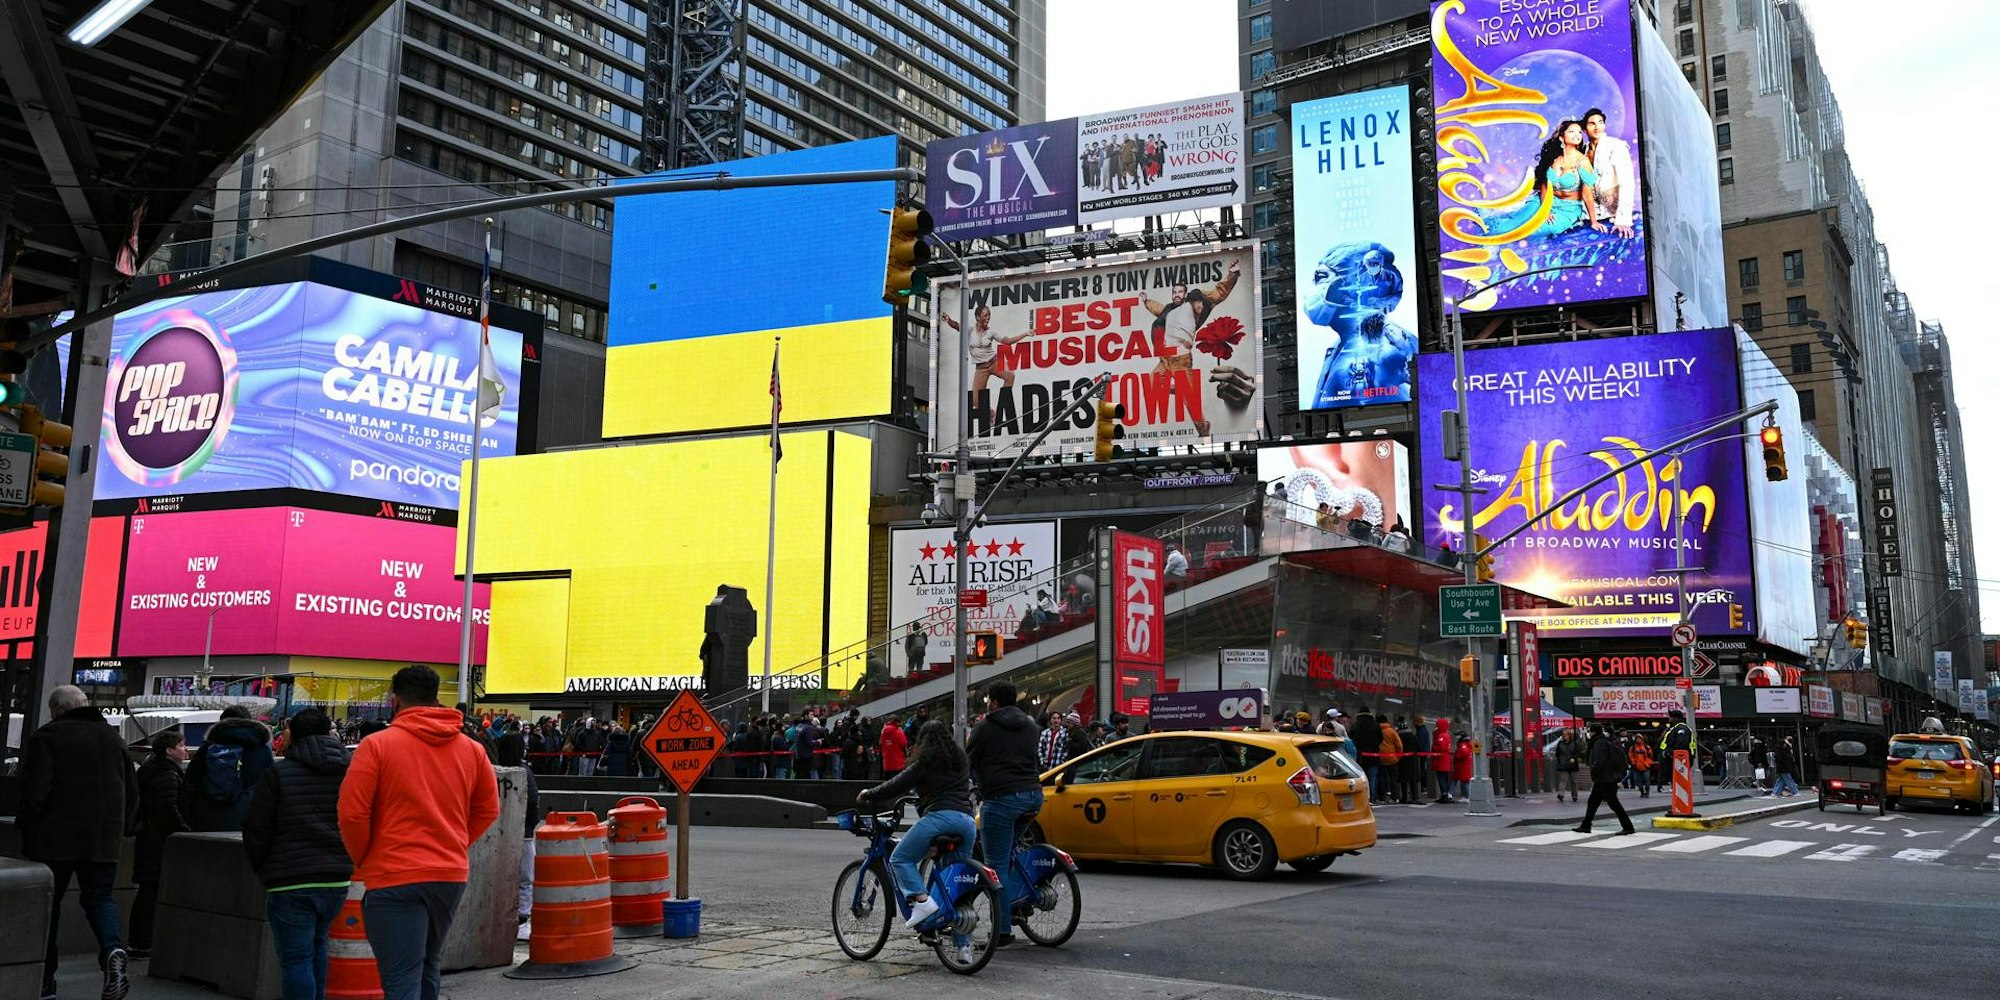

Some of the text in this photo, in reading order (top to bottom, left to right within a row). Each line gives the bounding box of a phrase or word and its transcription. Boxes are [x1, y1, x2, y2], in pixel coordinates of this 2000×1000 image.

[1478, 1, 1599, 31] TO A WHOLE
[1475, 15, 1604, 47] NEW WORLD!
[1081, 107, 1234, 136] AND INTERNATIONAL PHENOMENON
[1085, 100, 1230, 128] BROADWAY'S FUNNIEST SMASH HIT
[1175, 121, 1231, 140] THE PLAY
[1301, 110, 1400, 148] LENOX
[1170, 133, 1238, 152] THAT GOES
[1169, 150, 1238, 168] WRONG
[1318, 142, 1384, 174] HILL
[945, 136, 1056, 210] SIX
[1096, 200, 1112, 208] NEW
[1113, 197, 1137, 206] WORLD
[1138, 194, 1163, 203] STAGES
[1207, 184, 1232, 193] STREET
[967, 201, 1034, 218] THE MUSICAL
[968, 260, 1222, 310] WINNER! 8 TONY AWARDS
[426, 287, 480, 306] MARRIOTT
[425, 297, 474, 316] MARQUIS
[1035, 298, 1141, 336] BEST
[996, 327, 1178, 372] MUSICAL
[335, 334, 480, 392] CAMILA
[119, 361, 186, 402] POP
[1453, 357, 1697, 392] GREAT AVAILABILITY
[1363, 386, 1398, 398] NETFLIX
[1506, 380, 1640, 407] THIS WEEK!
[350, 425, 471, 455] NOW ON POP SPACE
[402, 420, 420, 435] FT.
[424, 425, 439, 438] ED
[443, 430, 498, 449] SHEEAN
[350, 459, 460, 490] pandora
[1146, 475, 1233, 487] OUTFRONT PRIME
[1470, 468, 1507, 487] Disney
[1439, 436, 1716, 535] Aladdin
[152, 496, 184, 504] MARRIOTT
[398, 505, 436, 515] MARRIOTT
[398, 512, 432, 522] MARQUIS
[1877, 488, 1898, 574] HOTEL
[1525, 537, 1621, 549] BROADWAY
[1628, 537, 1702, 550] MUSICAL
[187, 556, 219, 572] NEW
[380, 559, 423, 579] NEW
[969, 559, 1033, 583] RISE
[196, 574, 206, 589] &
[394, 580, 406, 598] &
[916, 586, 930, 596] for
[931, 585, 946, 595] the
[130, 590, 271, 609] EXISTING CUSTOMERS
[1127, 547, 1156, 654] tkts
[1446, 588, 1495, 598] Southbound
[1636, 593, 1673, 605] THIS
[295, 593, 490, 625] EXISTING CUSTOMRS
[925, 604, 1017, 621] TO A
[1451, 599, 1490, 608] Use 7 Ave
[1448, 625, 1494, 633] Best Route
[1547, 618, 1566, 626] BOX
[1568, 618, 1599, 626] OFFICE
[1602, 617, 1613, 625] AT
[1651, 616, 1668, 624] 7TH
[1525, 631, 1536, 696] tkts
[1558, 655, 1682, 676] DOS CAMINOS
[567, 676, 652, 692] AMERICAN
[1603, 689, 1676, 700] DOS CAMINOS
[1598, 702, 1684, 711] WE ARE OPEN
[661, 738, 710, 751] WORK ZONE
[672, 758, 699, 771] AHEAD
[1088, 803, 1101, 820] T
[1770, 820, 1944, 838] ONLY
